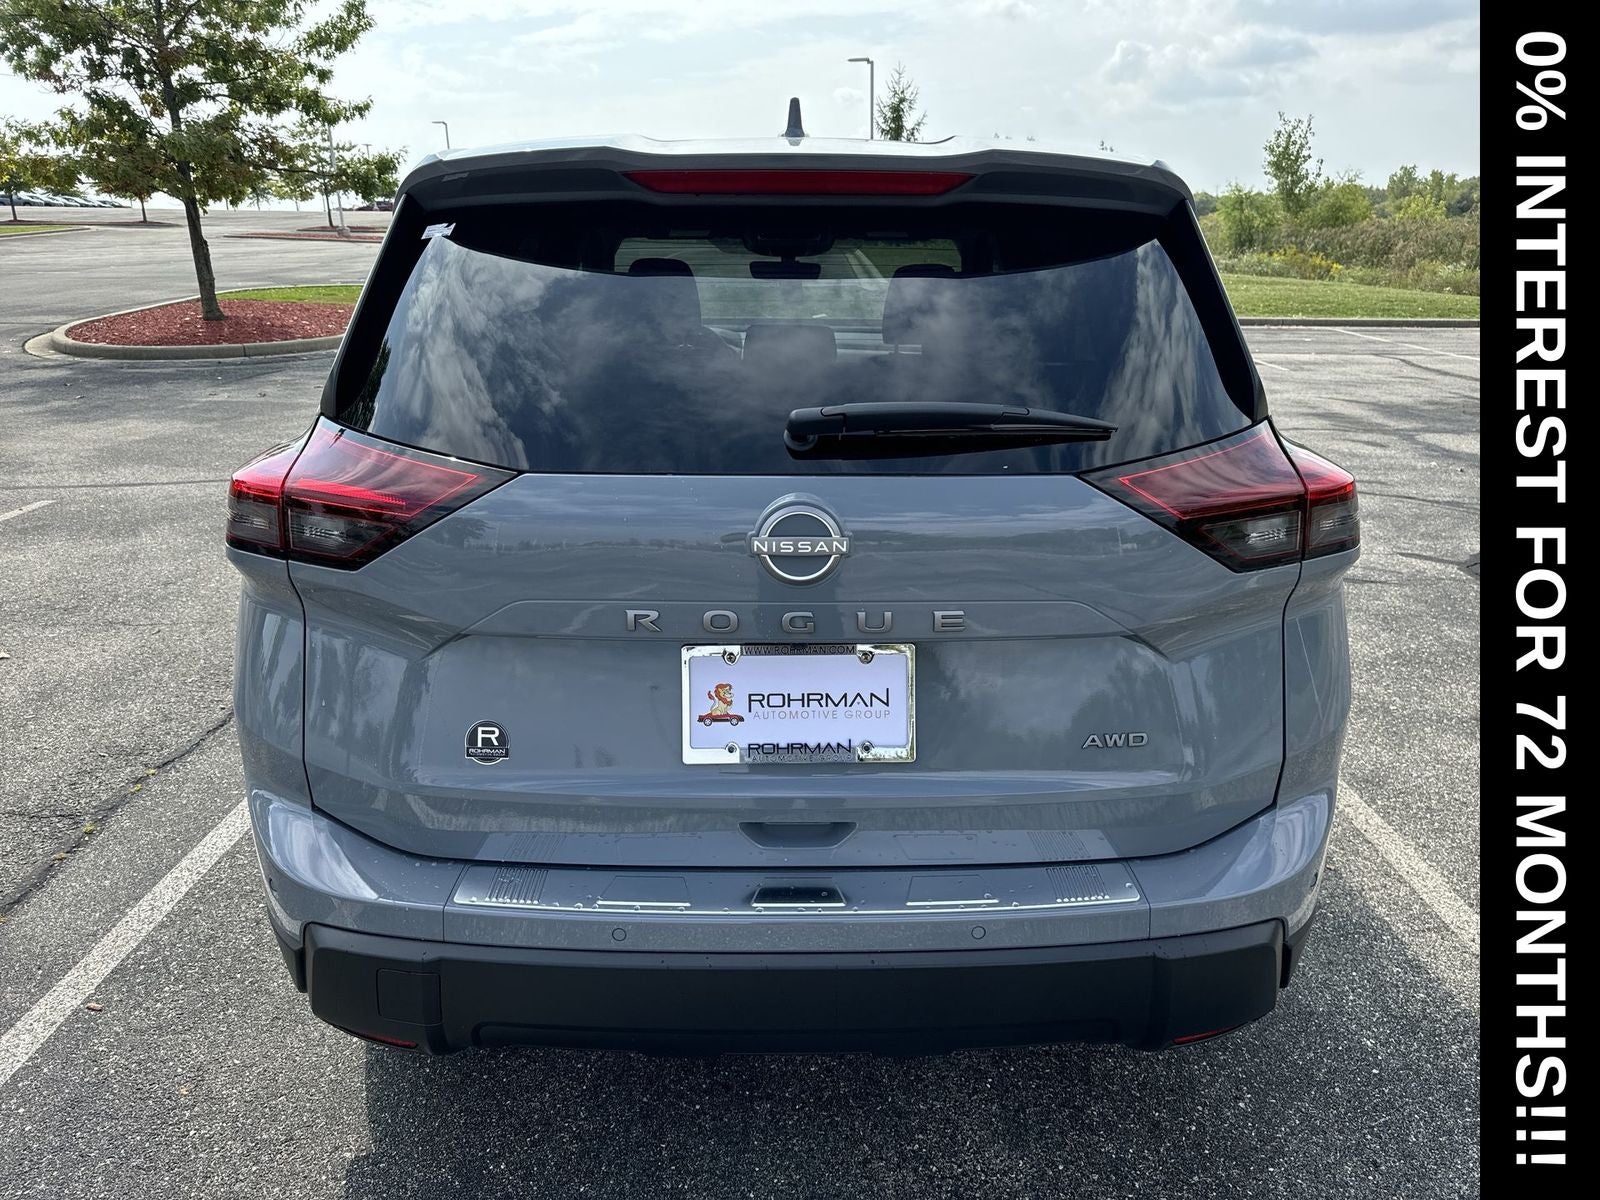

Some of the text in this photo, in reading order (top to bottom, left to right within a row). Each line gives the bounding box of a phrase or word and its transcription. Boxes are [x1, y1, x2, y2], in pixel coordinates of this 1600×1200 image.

[753, 540, 848, 553] NISSAN
[625, 609, 966, 633] ROGUE
[748, 688, 890, 712] ROHRMAN
[753, 710, 891, 719] AUTOMOTIVE GROUP
[477, 726, 500, 747] R
[1082, 732, 1149, 749] AWD
[748, 739, 851, 757] ROHRMAN
